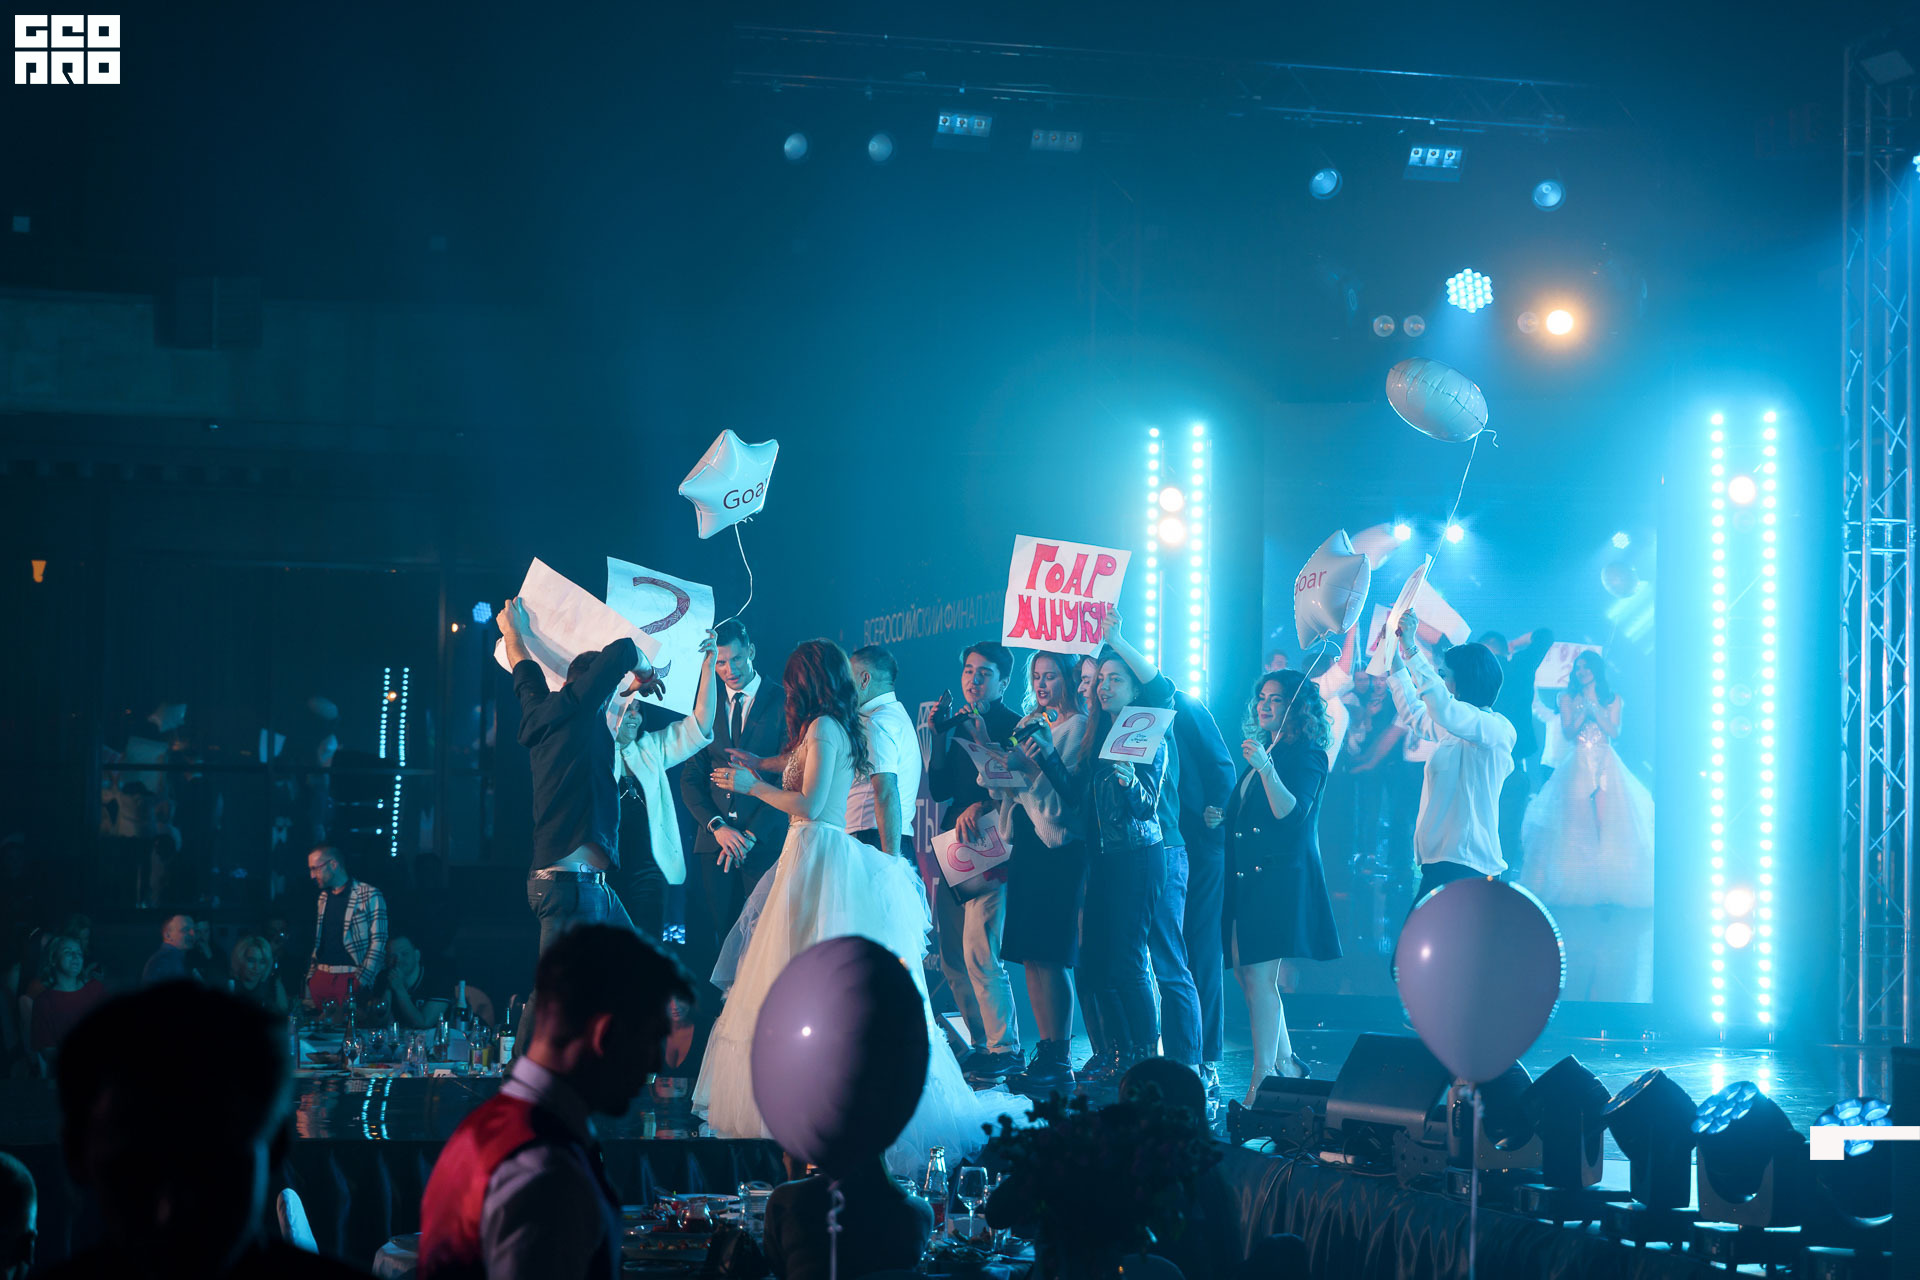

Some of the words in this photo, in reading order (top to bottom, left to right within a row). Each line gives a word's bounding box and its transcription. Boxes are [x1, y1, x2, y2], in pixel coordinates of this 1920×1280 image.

[722, 479, 768, 509] Goa
[1294, 571, 1327, 596] oar
[1109, 712, 1156, 758] 2
[947, 825, 1007, 873] 2
